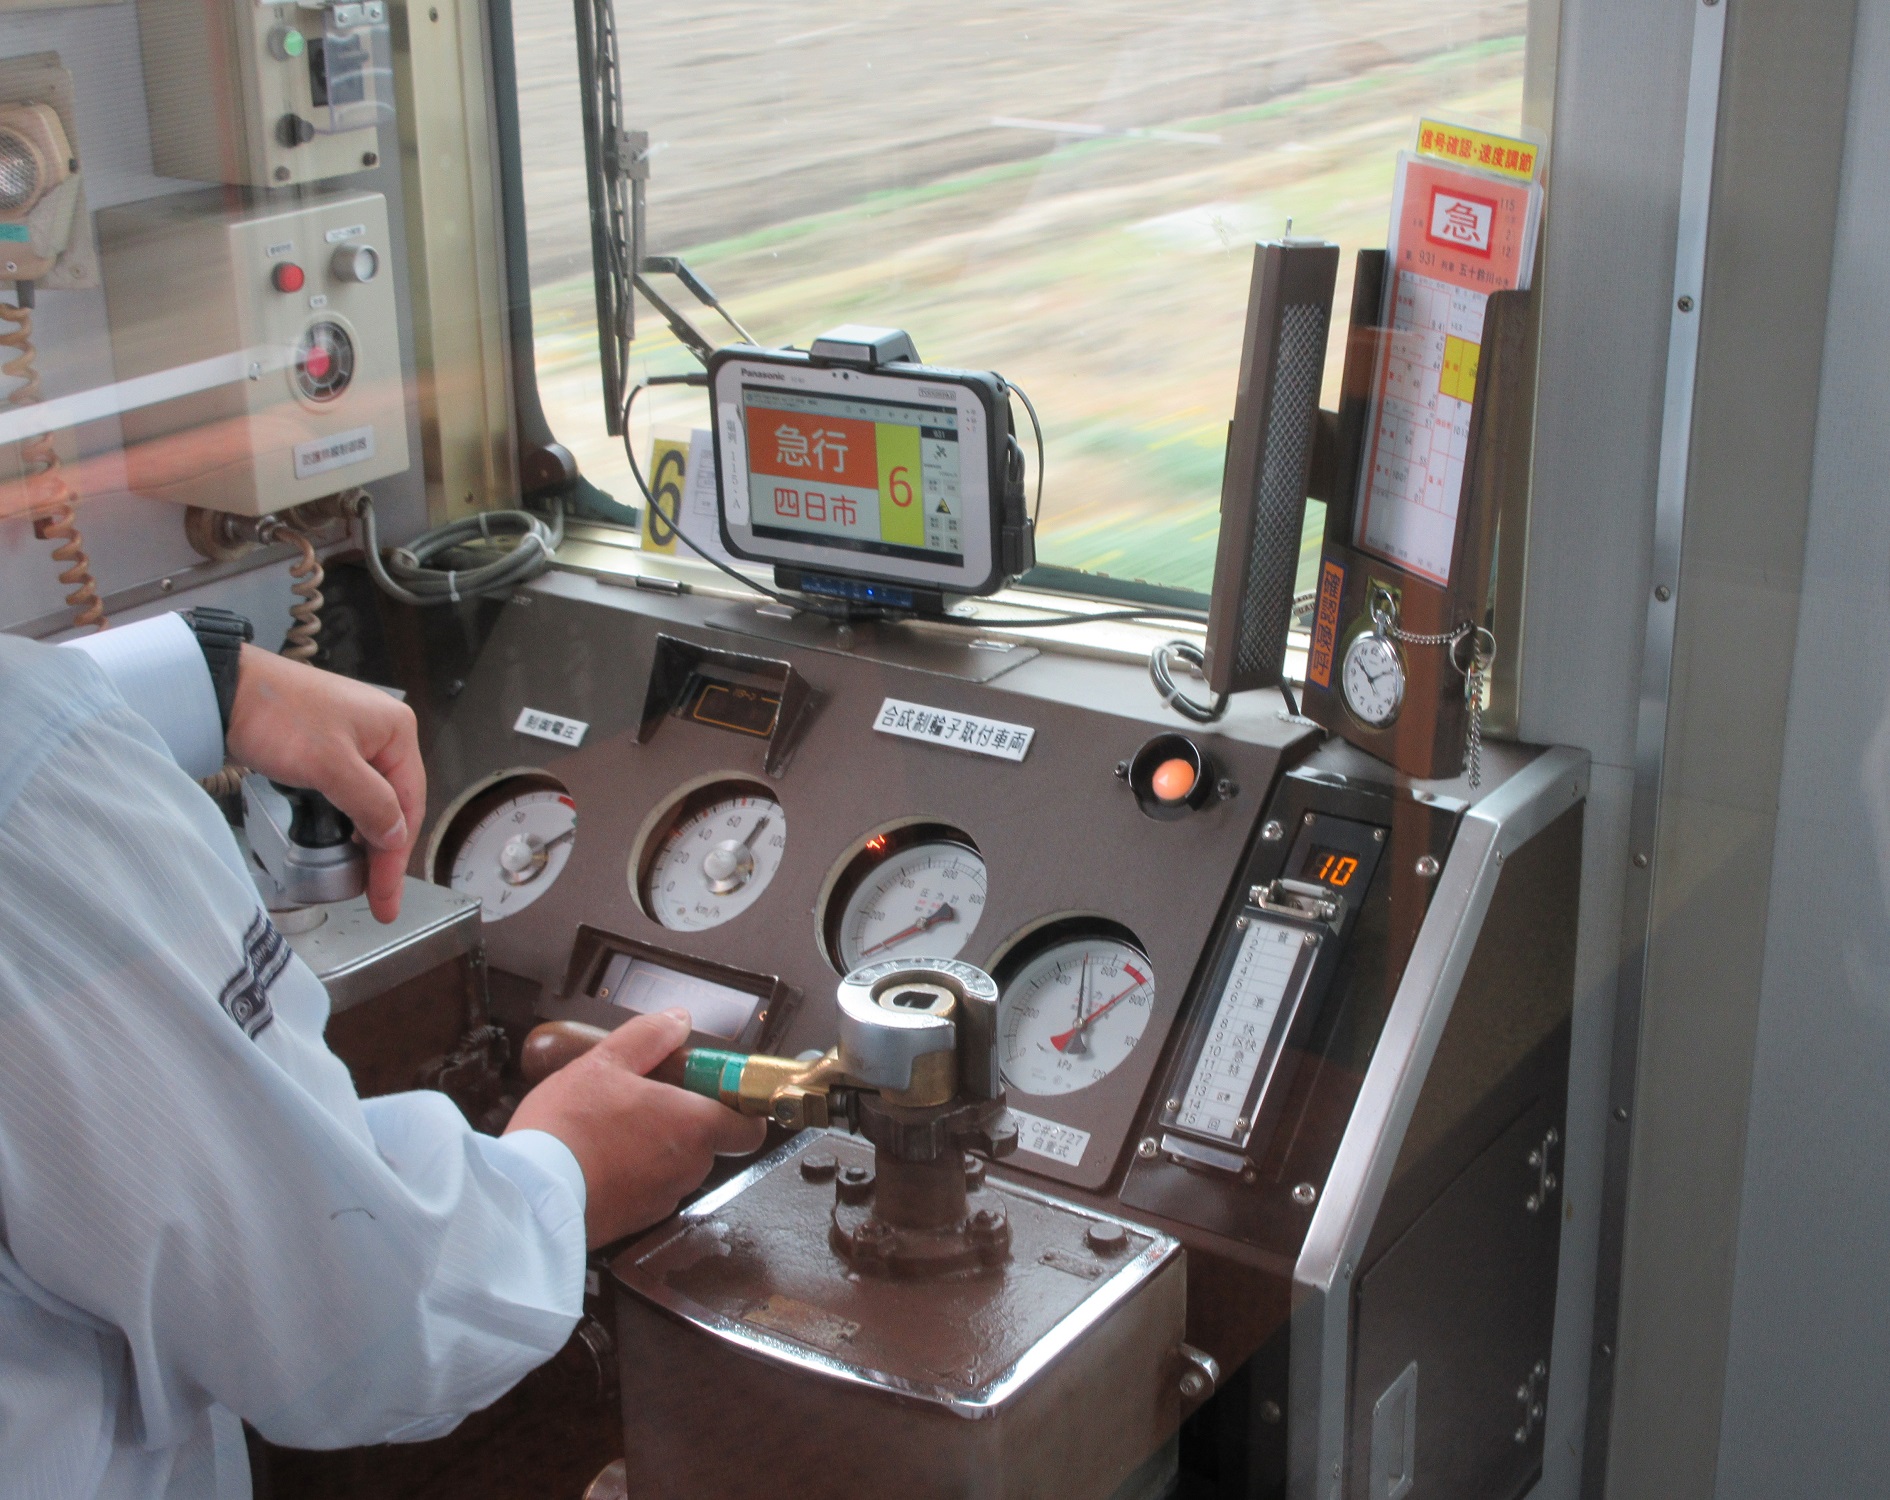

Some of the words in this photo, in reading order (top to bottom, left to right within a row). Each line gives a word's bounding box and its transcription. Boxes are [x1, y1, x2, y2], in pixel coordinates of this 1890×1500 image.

[1421, 129, 1533, 173] 信号確認・速度調節
[1445, 202, 1481, 243] 急
[1420, 250, 1436, 267] 931
[741, 368, 785, 381] Panasonic
[775, 424, 848, 473] 急行
[889, 466, 913, 508] 6
[649, 450, 686, 546] 6
[774, 487, 857, 527] 四日市
[880, 705, 1028, 754] 合成制輪子取付車両
[1319, 855, 1359, 887] 10
[1249, 939, 1259, 951] 2
[1244, 952, 1254, 963] 3
[1230, 991, 1239, 1003] 6
[1219, 1018, 1229, 1030] 8
[1214, 1031, 1224, 1043] 9
[1209, 1045, 1222, 1057] 10
[1056, 1057, 1073, 1072] kPa
[1203, 1058, 1215, 1070] 11
[1199, 1071, 1212, 1084] 12
[1194, 1085, 1207, 1097] 13
[1189, 1099, 1201, 1110] 14
[1184, 1112, 1197, 1125] 15
